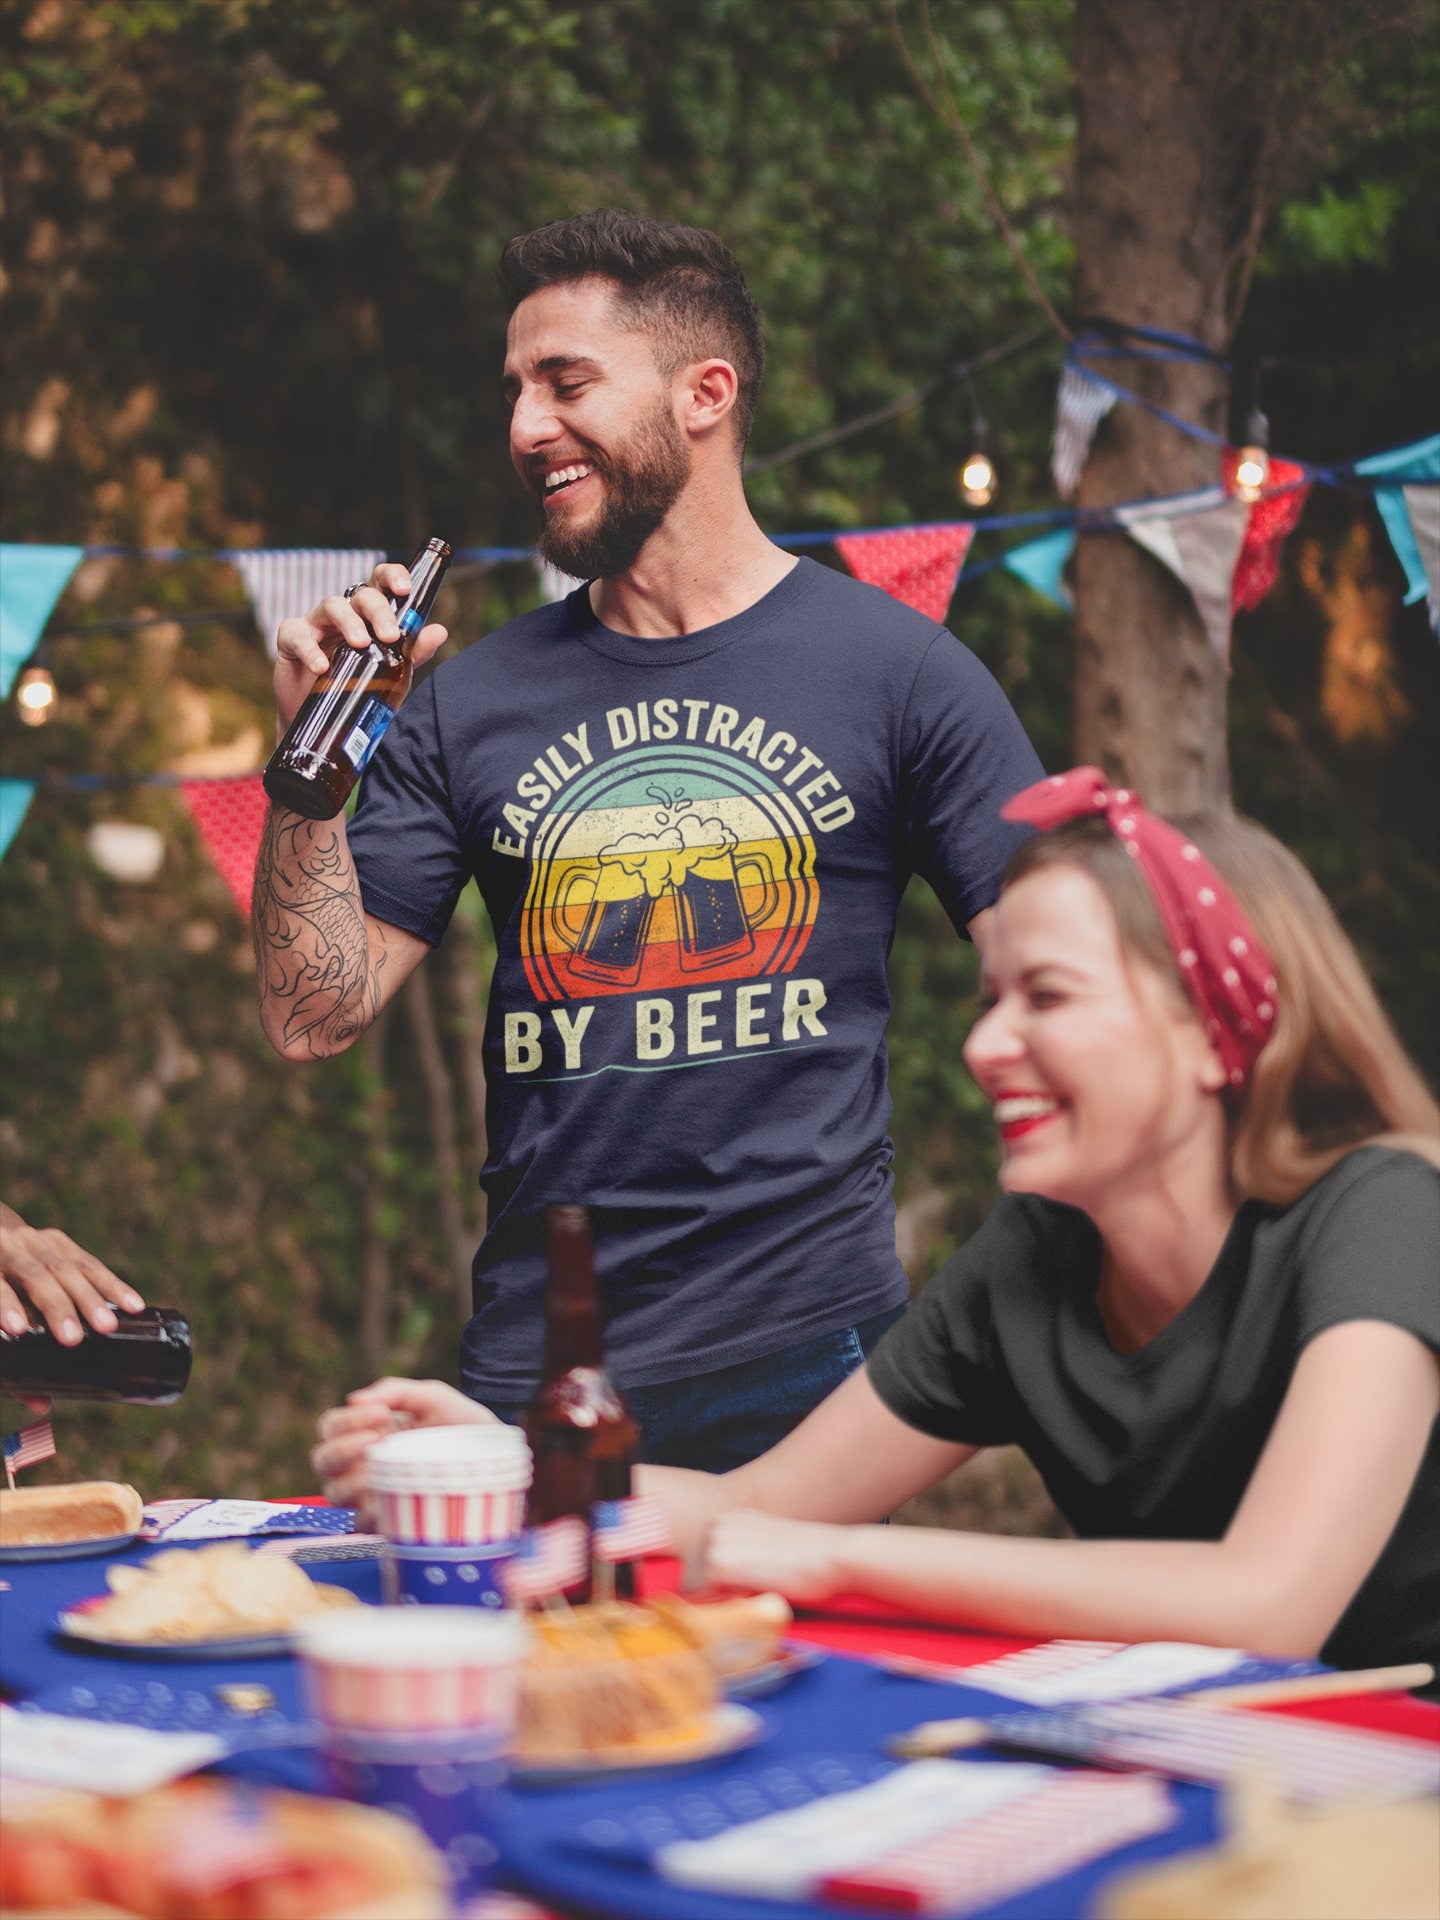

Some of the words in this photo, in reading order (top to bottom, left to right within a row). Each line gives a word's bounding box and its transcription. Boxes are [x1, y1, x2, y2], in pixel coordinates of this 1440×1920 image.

[492, 722, 594, 858] EASILY
[606, 698, 856, 833] DISTRACTED
[504, 1006, 595, 1074] BY
[636, 978, 828, 1061] BEER
